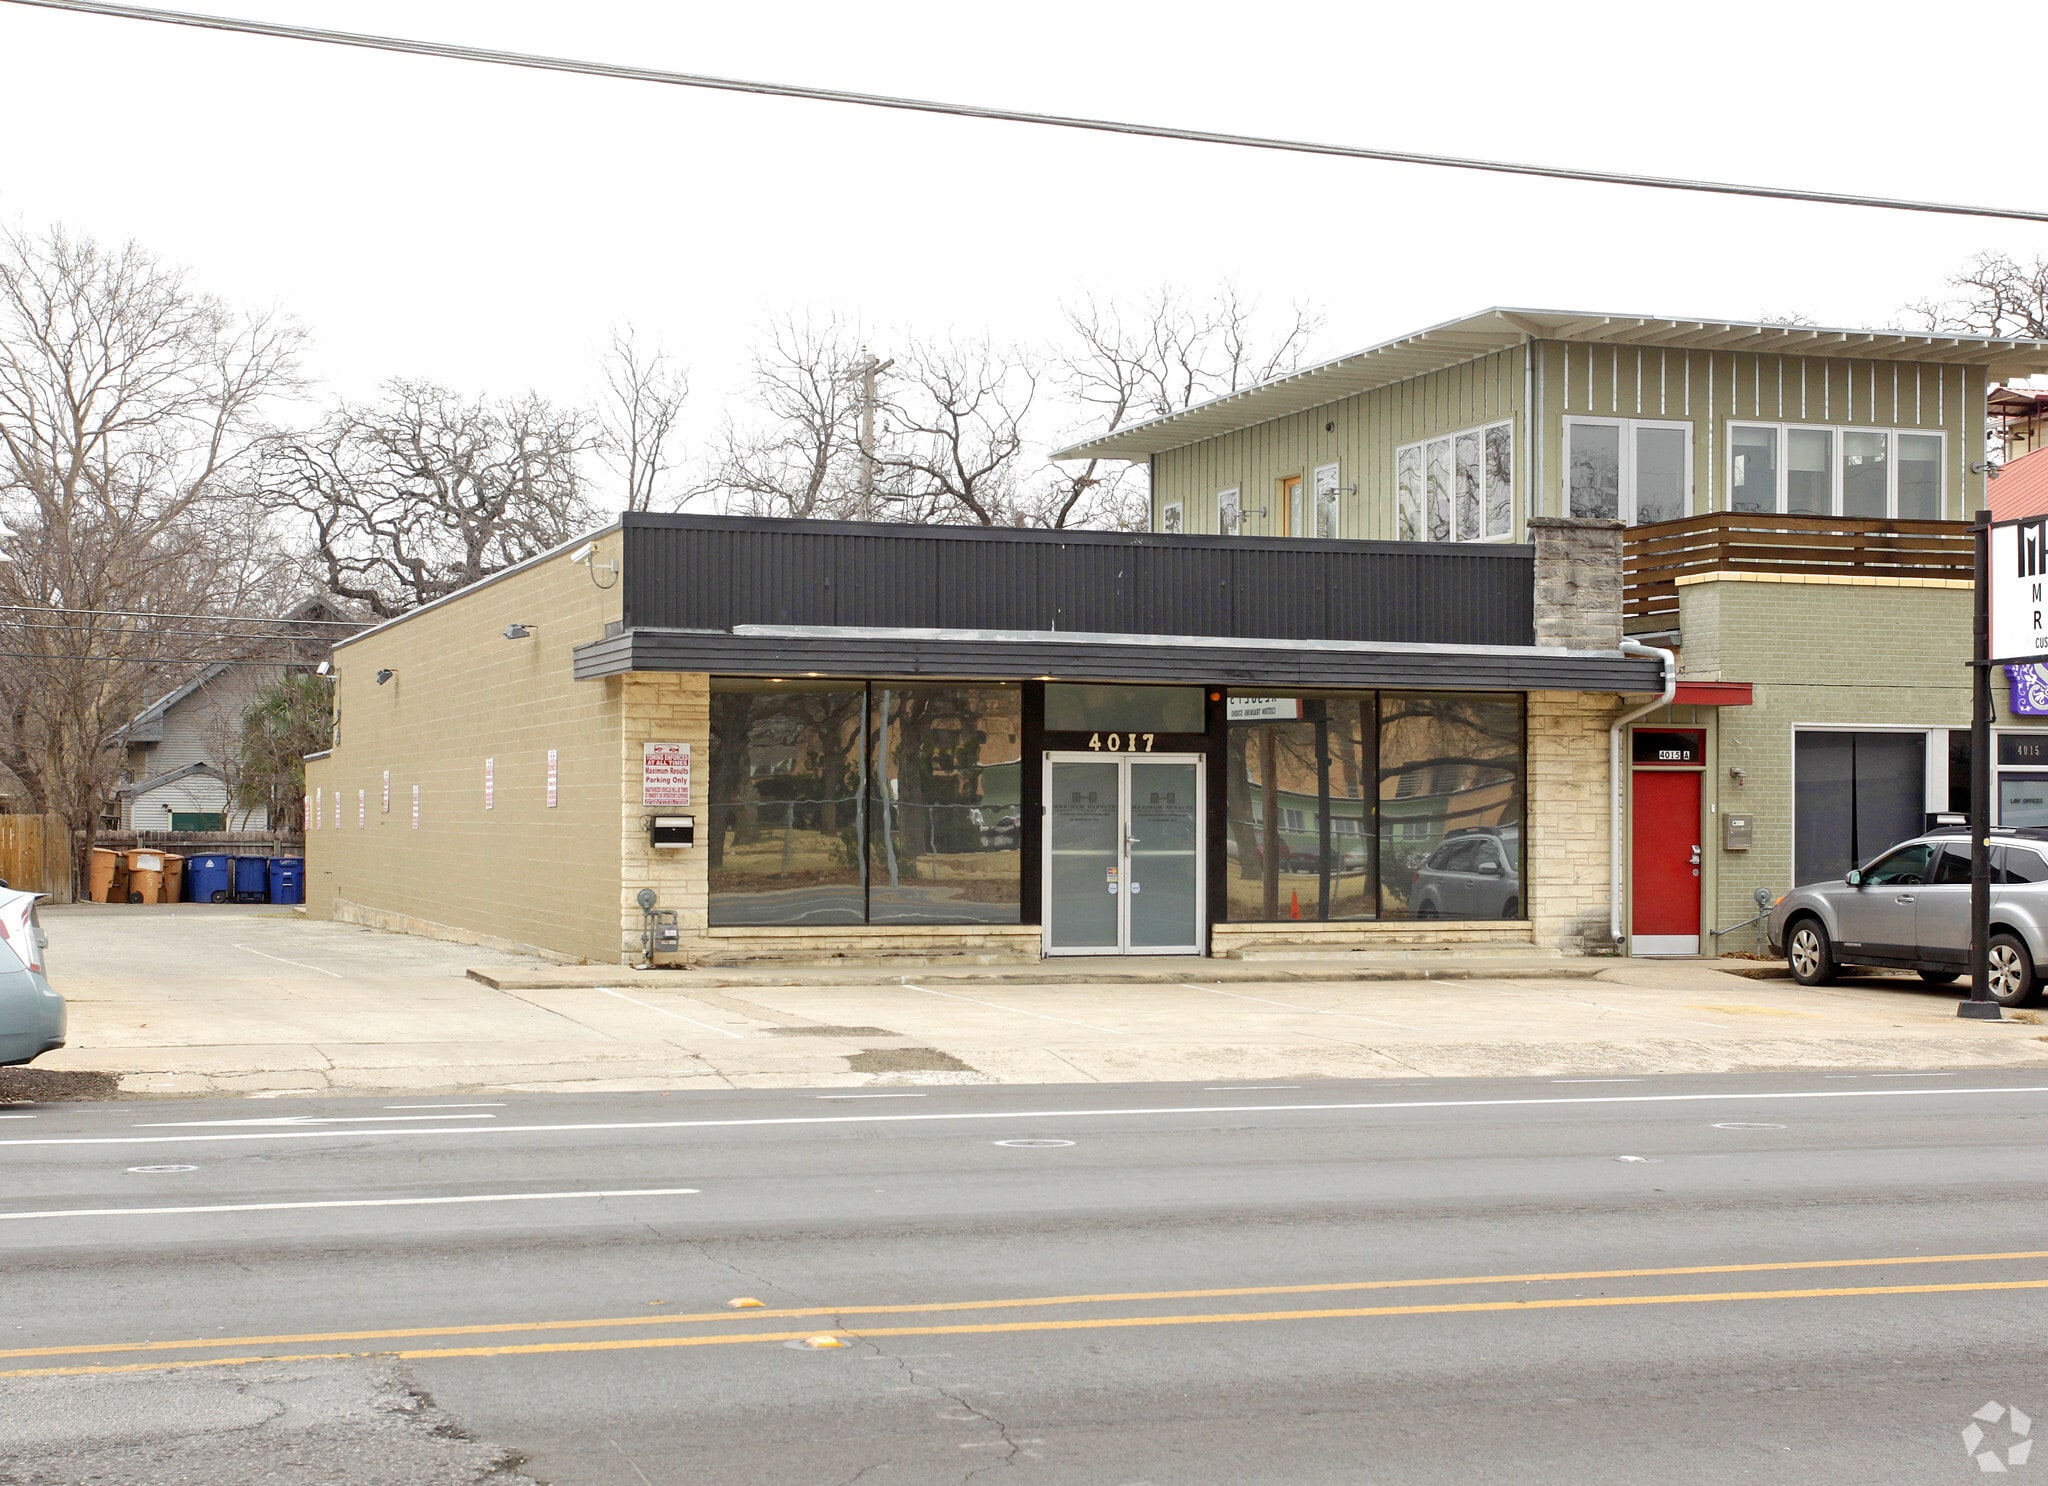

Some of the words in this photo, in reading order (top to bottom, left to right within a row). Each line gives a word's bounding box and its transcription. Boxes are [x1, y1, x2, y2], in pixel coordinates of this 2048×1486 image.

[2032, 583, 2042, 603] M
[2033, 610, 2042, 630] R
[1088, 733, 1154, 752] 4017
[1659, 751, 1680, 759] 4015
[2017, 745, 2039, 756] 4015
[646, 777, 671, 785] Parking
[673, 777, 687, 785] Only
